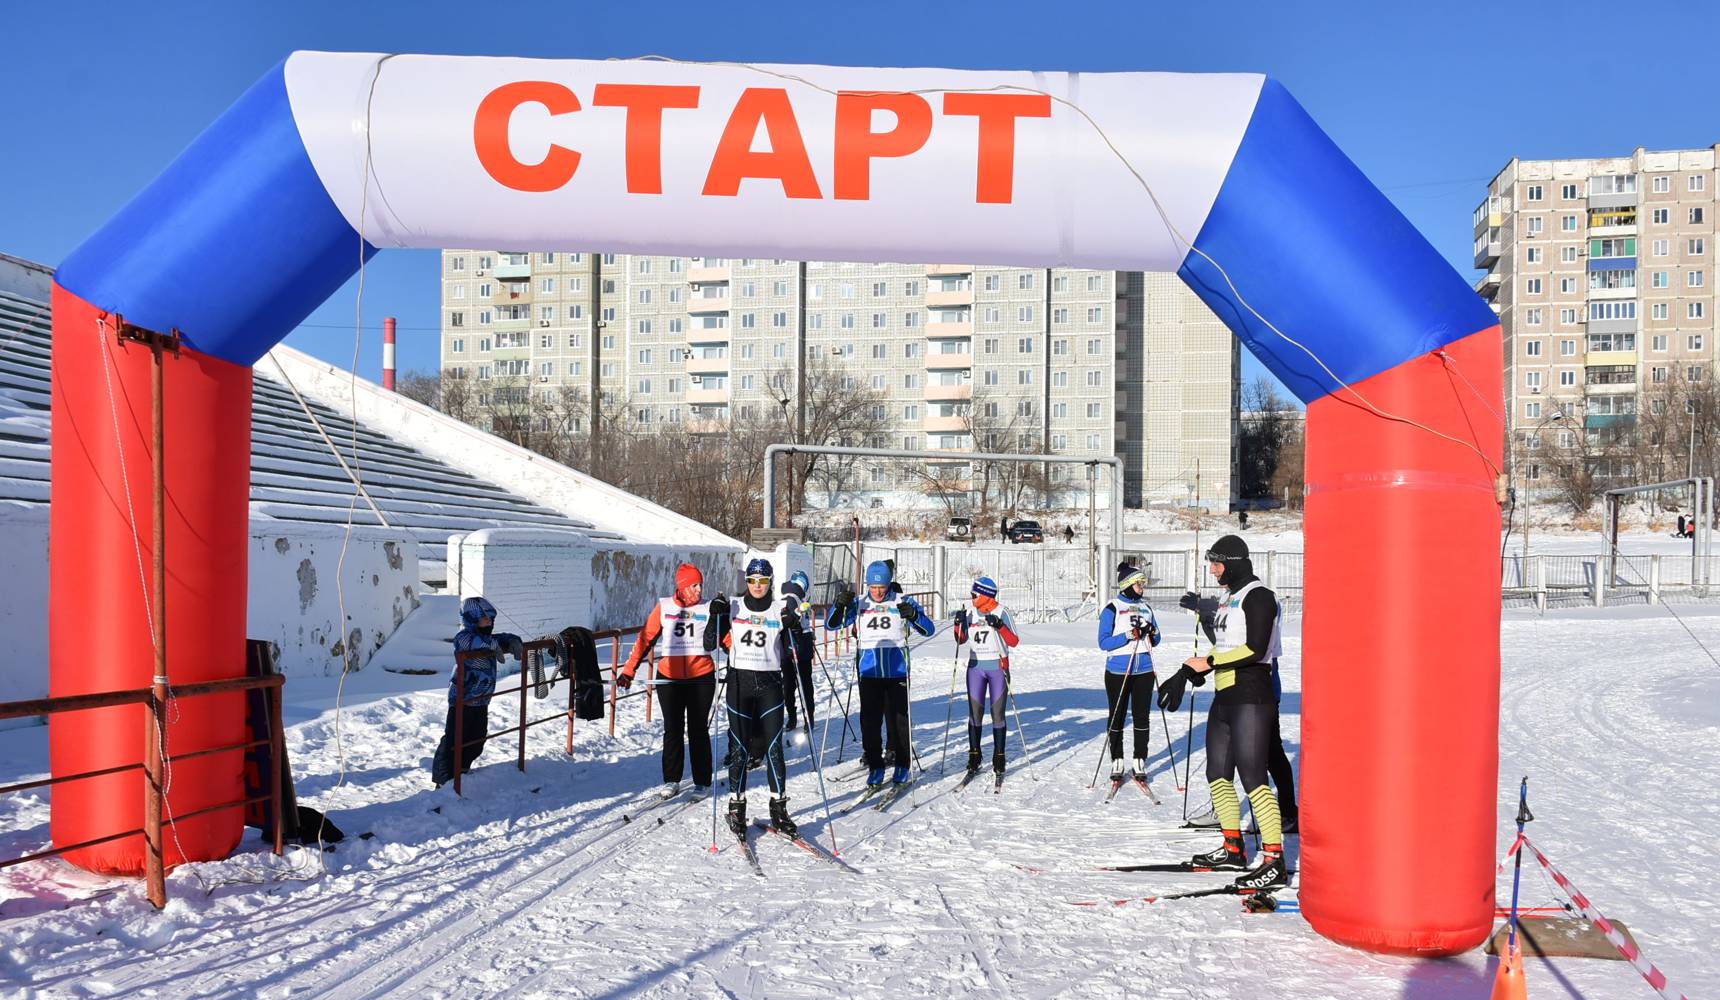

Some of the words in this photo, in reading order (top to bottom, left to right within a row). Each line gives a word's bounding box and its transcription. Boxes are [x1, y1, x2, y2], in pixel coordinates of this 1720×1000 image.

[473, 80, 1051, 204] СТАРТ
[867, 616, 891, 630] 48
[1129, 614, 1144, 628] 5
[674, 622, 694, 637] 51
[740, 629, 767, 648] 43
[973, 630, 990, 644] 47
